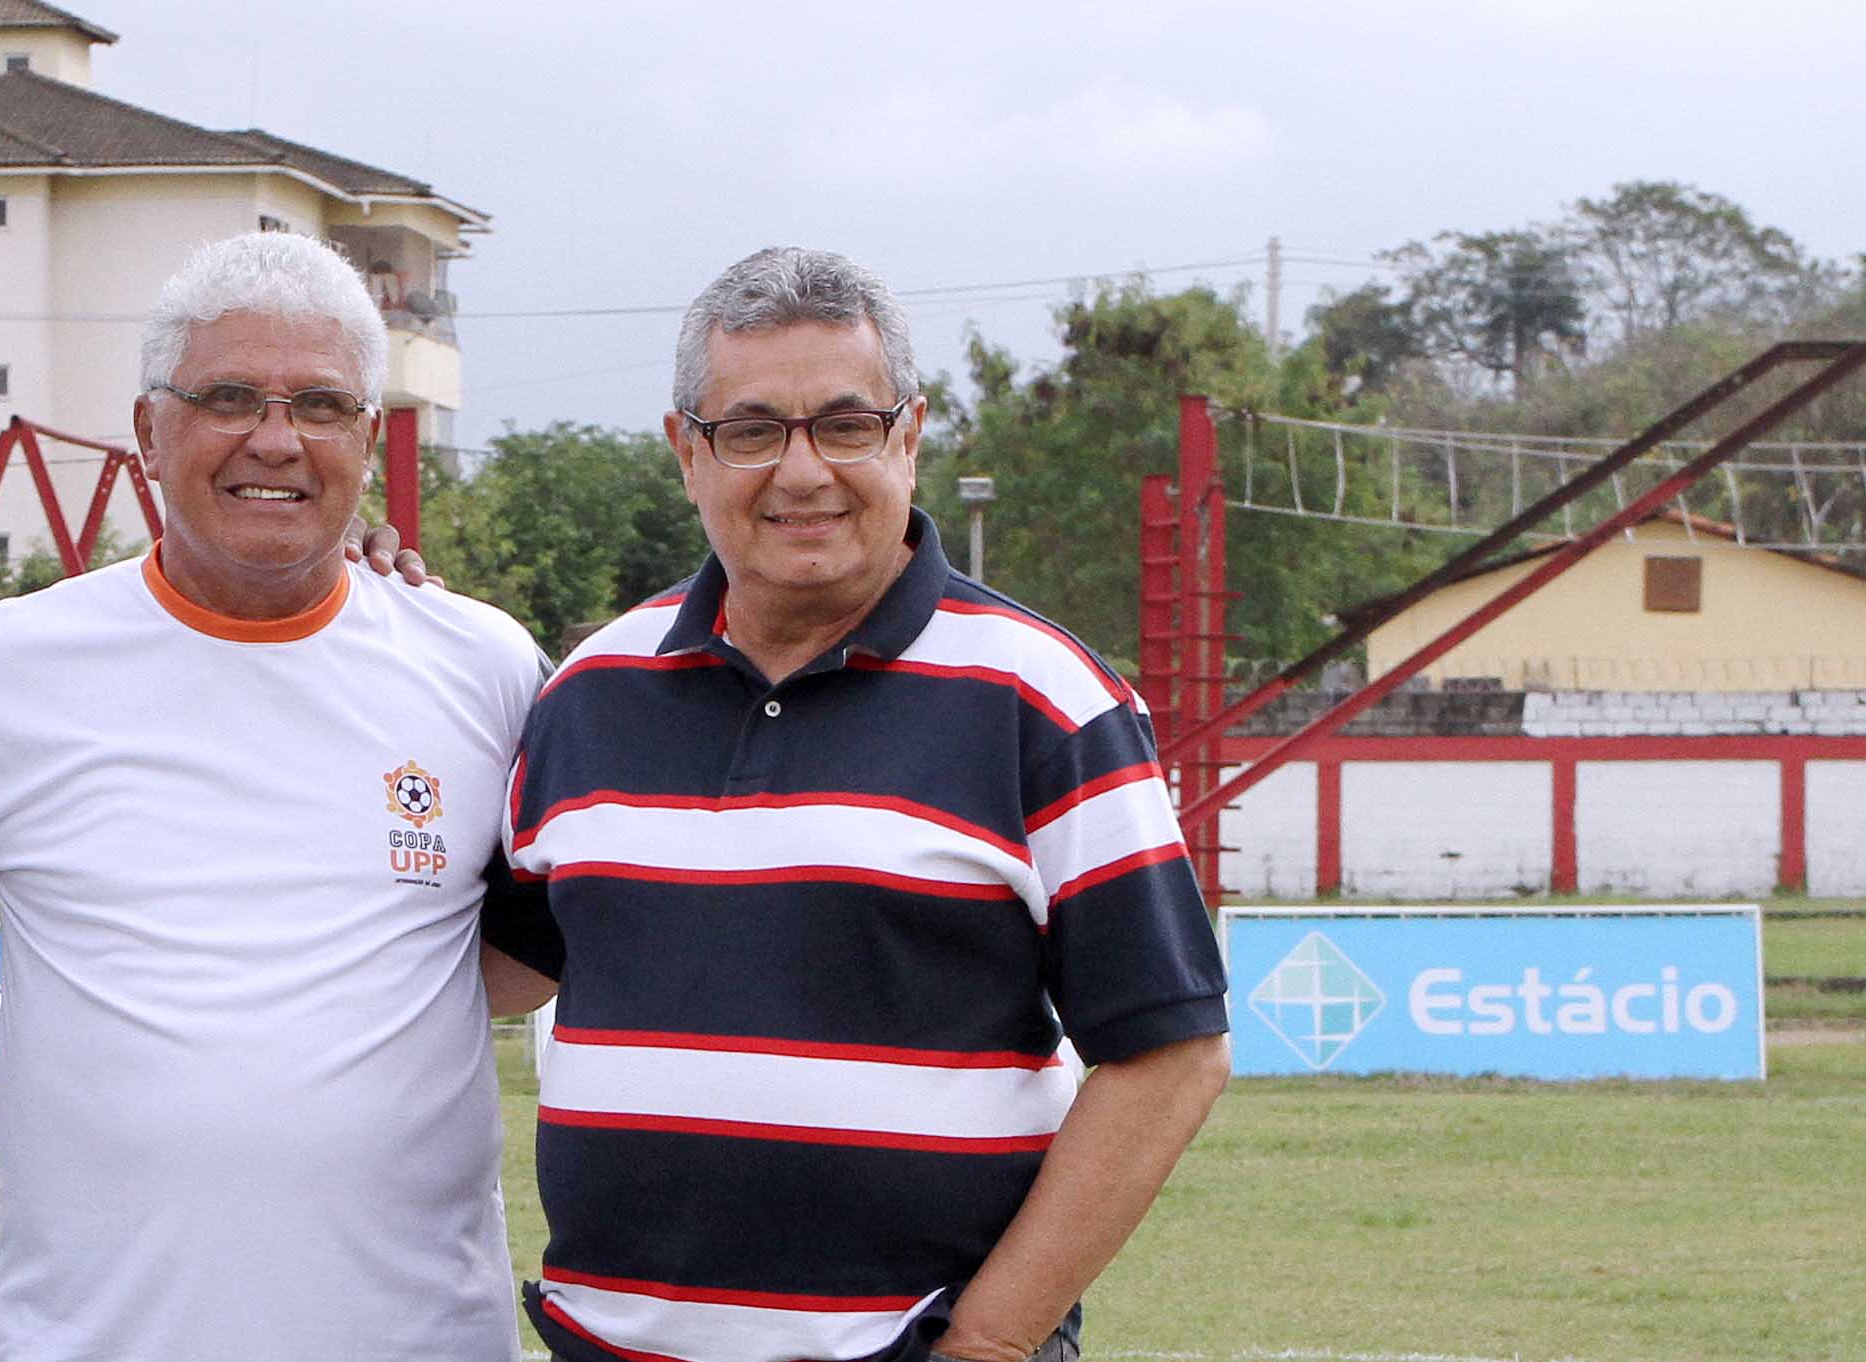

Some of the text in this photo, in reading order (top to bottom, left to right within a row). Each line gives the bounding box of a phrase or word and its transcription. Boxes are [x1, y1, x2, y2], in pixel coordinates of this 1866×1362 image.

[389, 830, 446, 853] COPA
[390, 850, 447, 875] UPP
[1409, 966, 1739, 1035] Estácio
